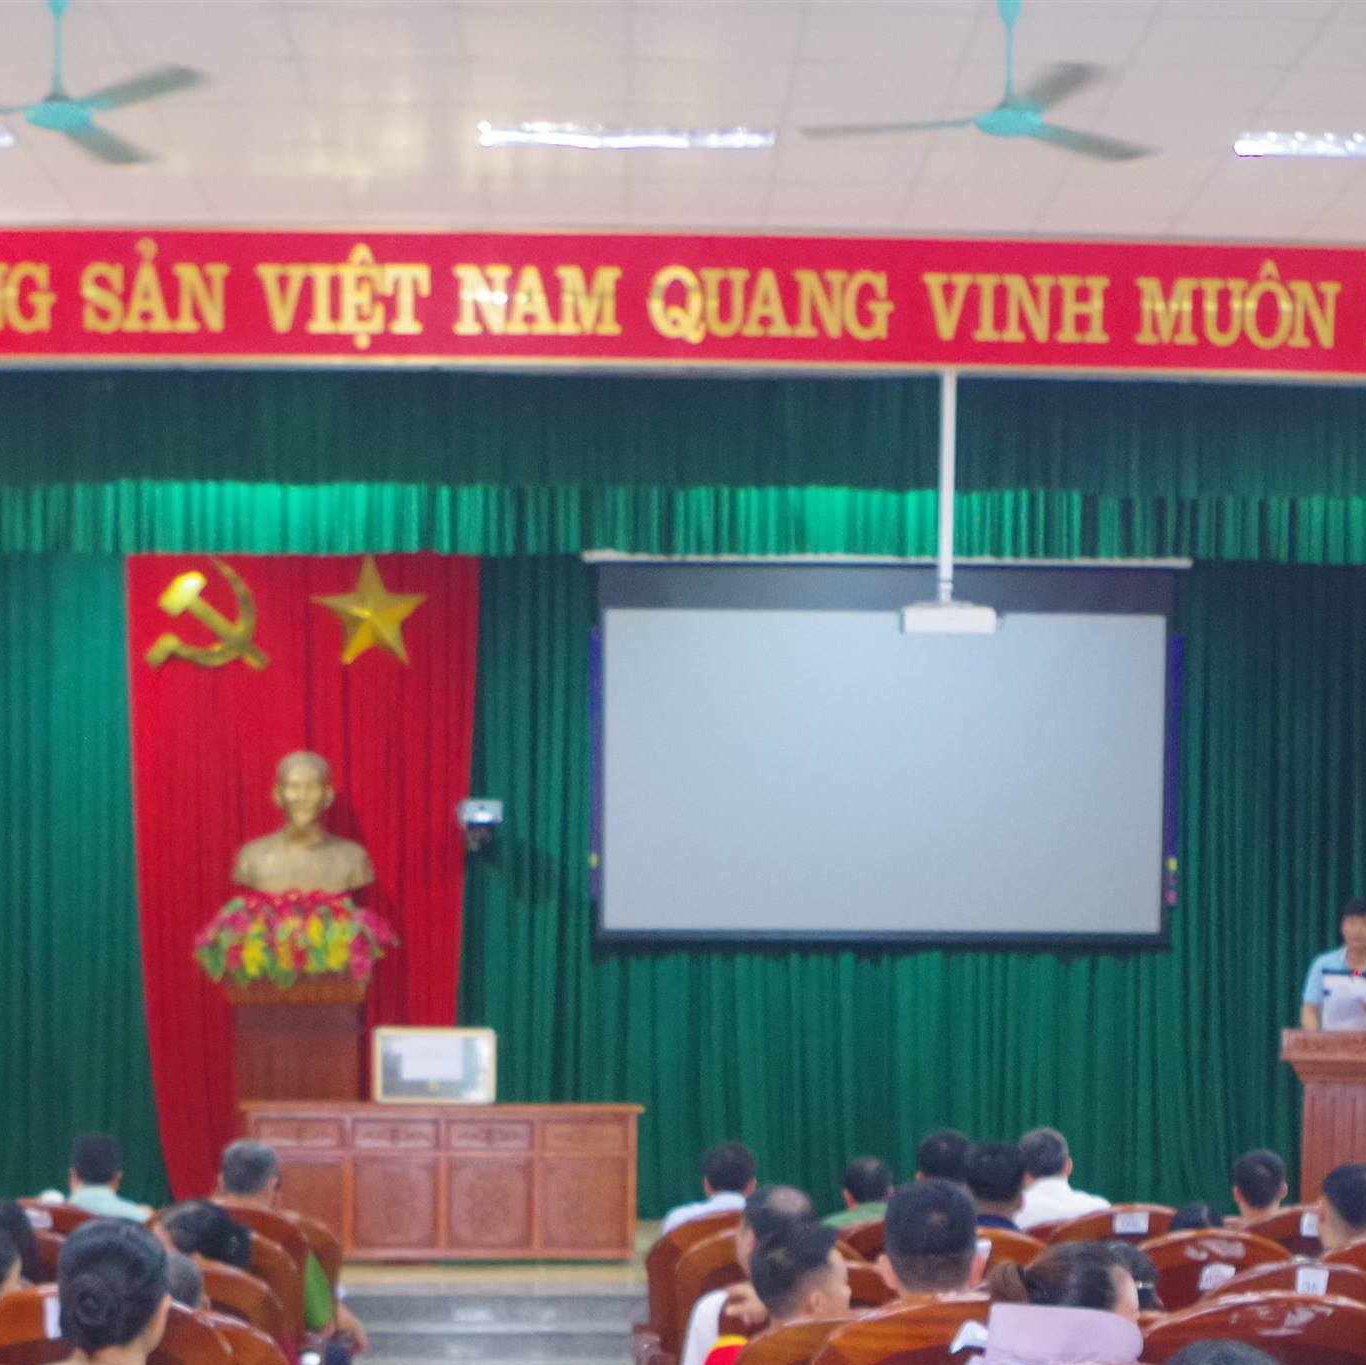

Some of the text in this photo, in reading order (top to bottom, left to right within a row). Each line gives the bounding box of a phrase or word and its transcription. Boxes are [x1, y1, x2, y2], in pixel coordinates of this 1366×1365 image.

[80, 238, 228, 334] SẢN
[256, 242, 431, 350] VIỆT
[453, 264, 621, 337] NAM
[648, 264, 894, 342] QUANG
[923, 272, 1108, 344] VINH
[1135, 260, 1341, 349] MUÔN
